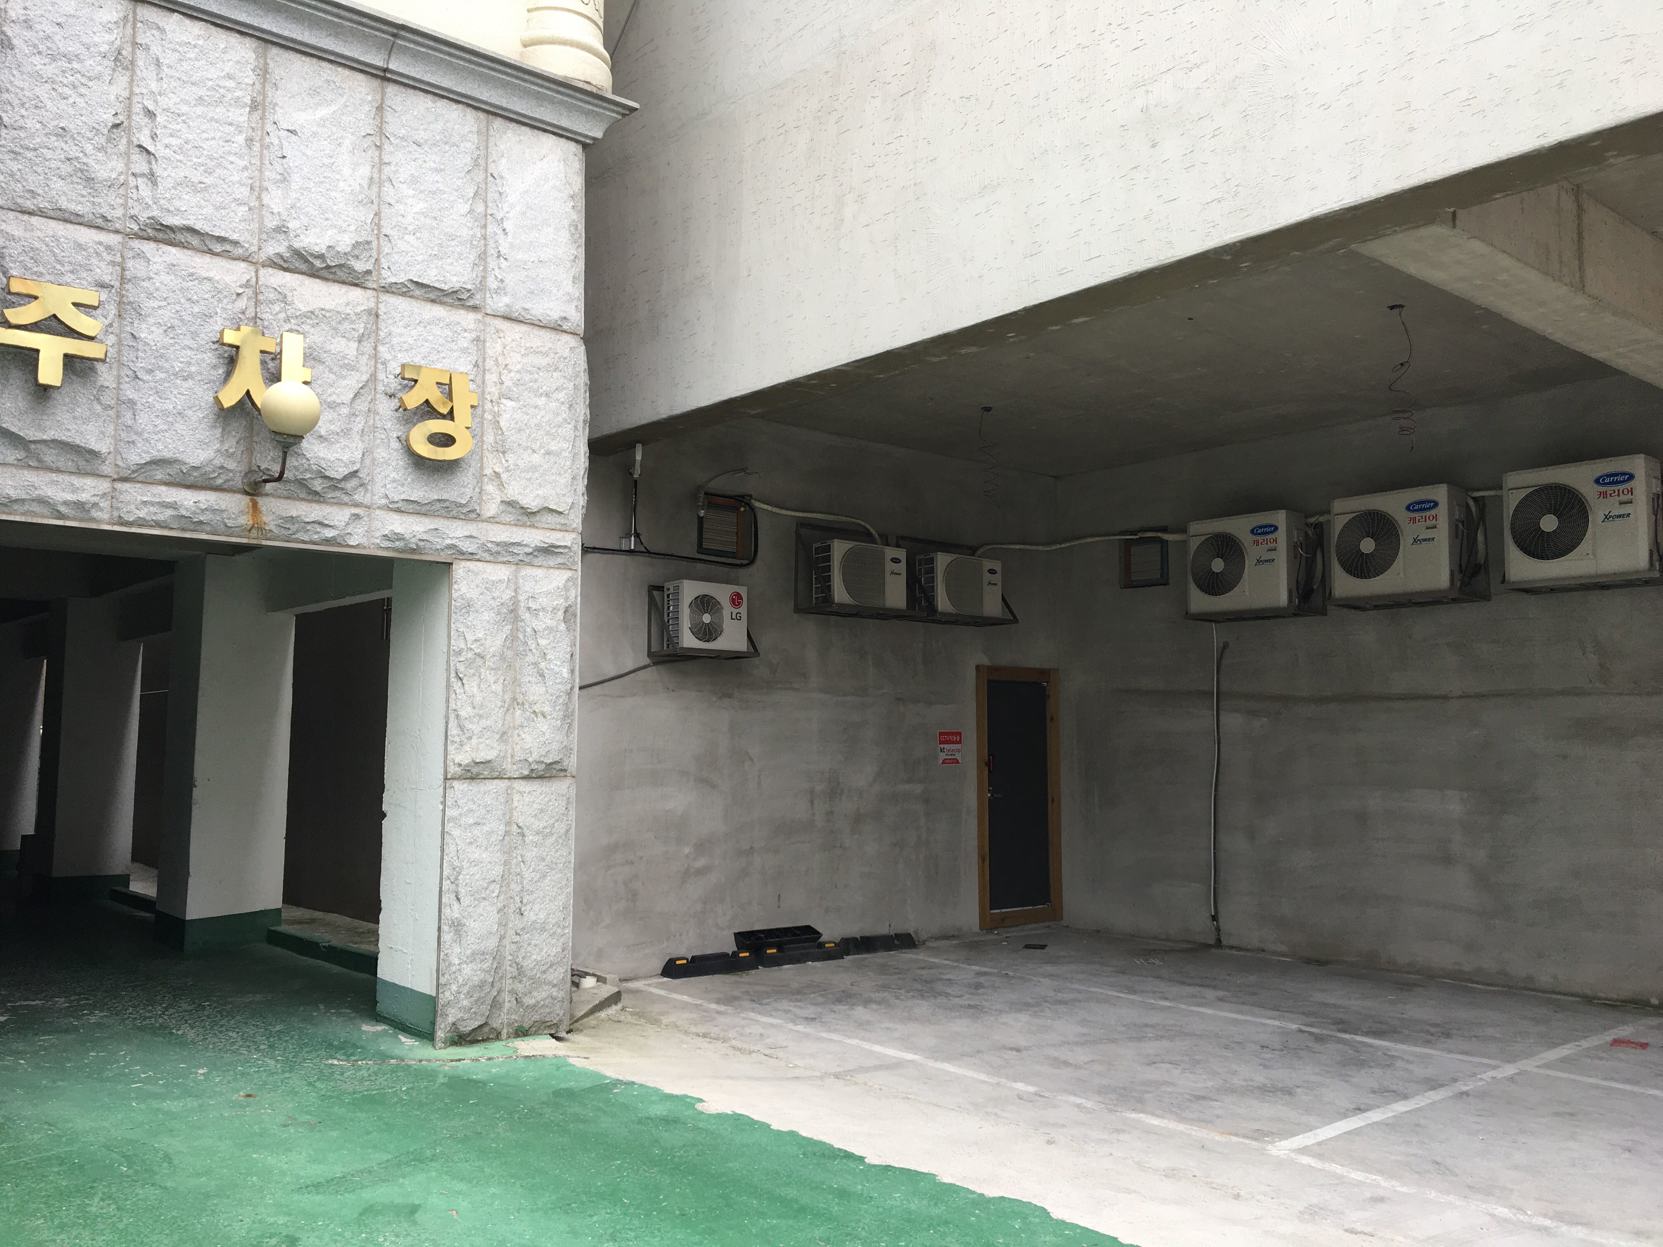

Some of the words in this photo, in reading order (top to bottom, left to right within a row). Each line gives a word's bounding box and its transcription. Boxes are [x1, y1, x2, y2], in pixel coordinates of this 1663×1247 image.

[0, 276, 479, 461] 주차장
[1599, 473, 1631, 485] Carrier
[1597, 487, 1634, 499] 캐리어
[1409, 501, 1435, 511] Carrier
[1407, 514, 1438, 525] 캐리어
[730, 611, 742, 621] LG
